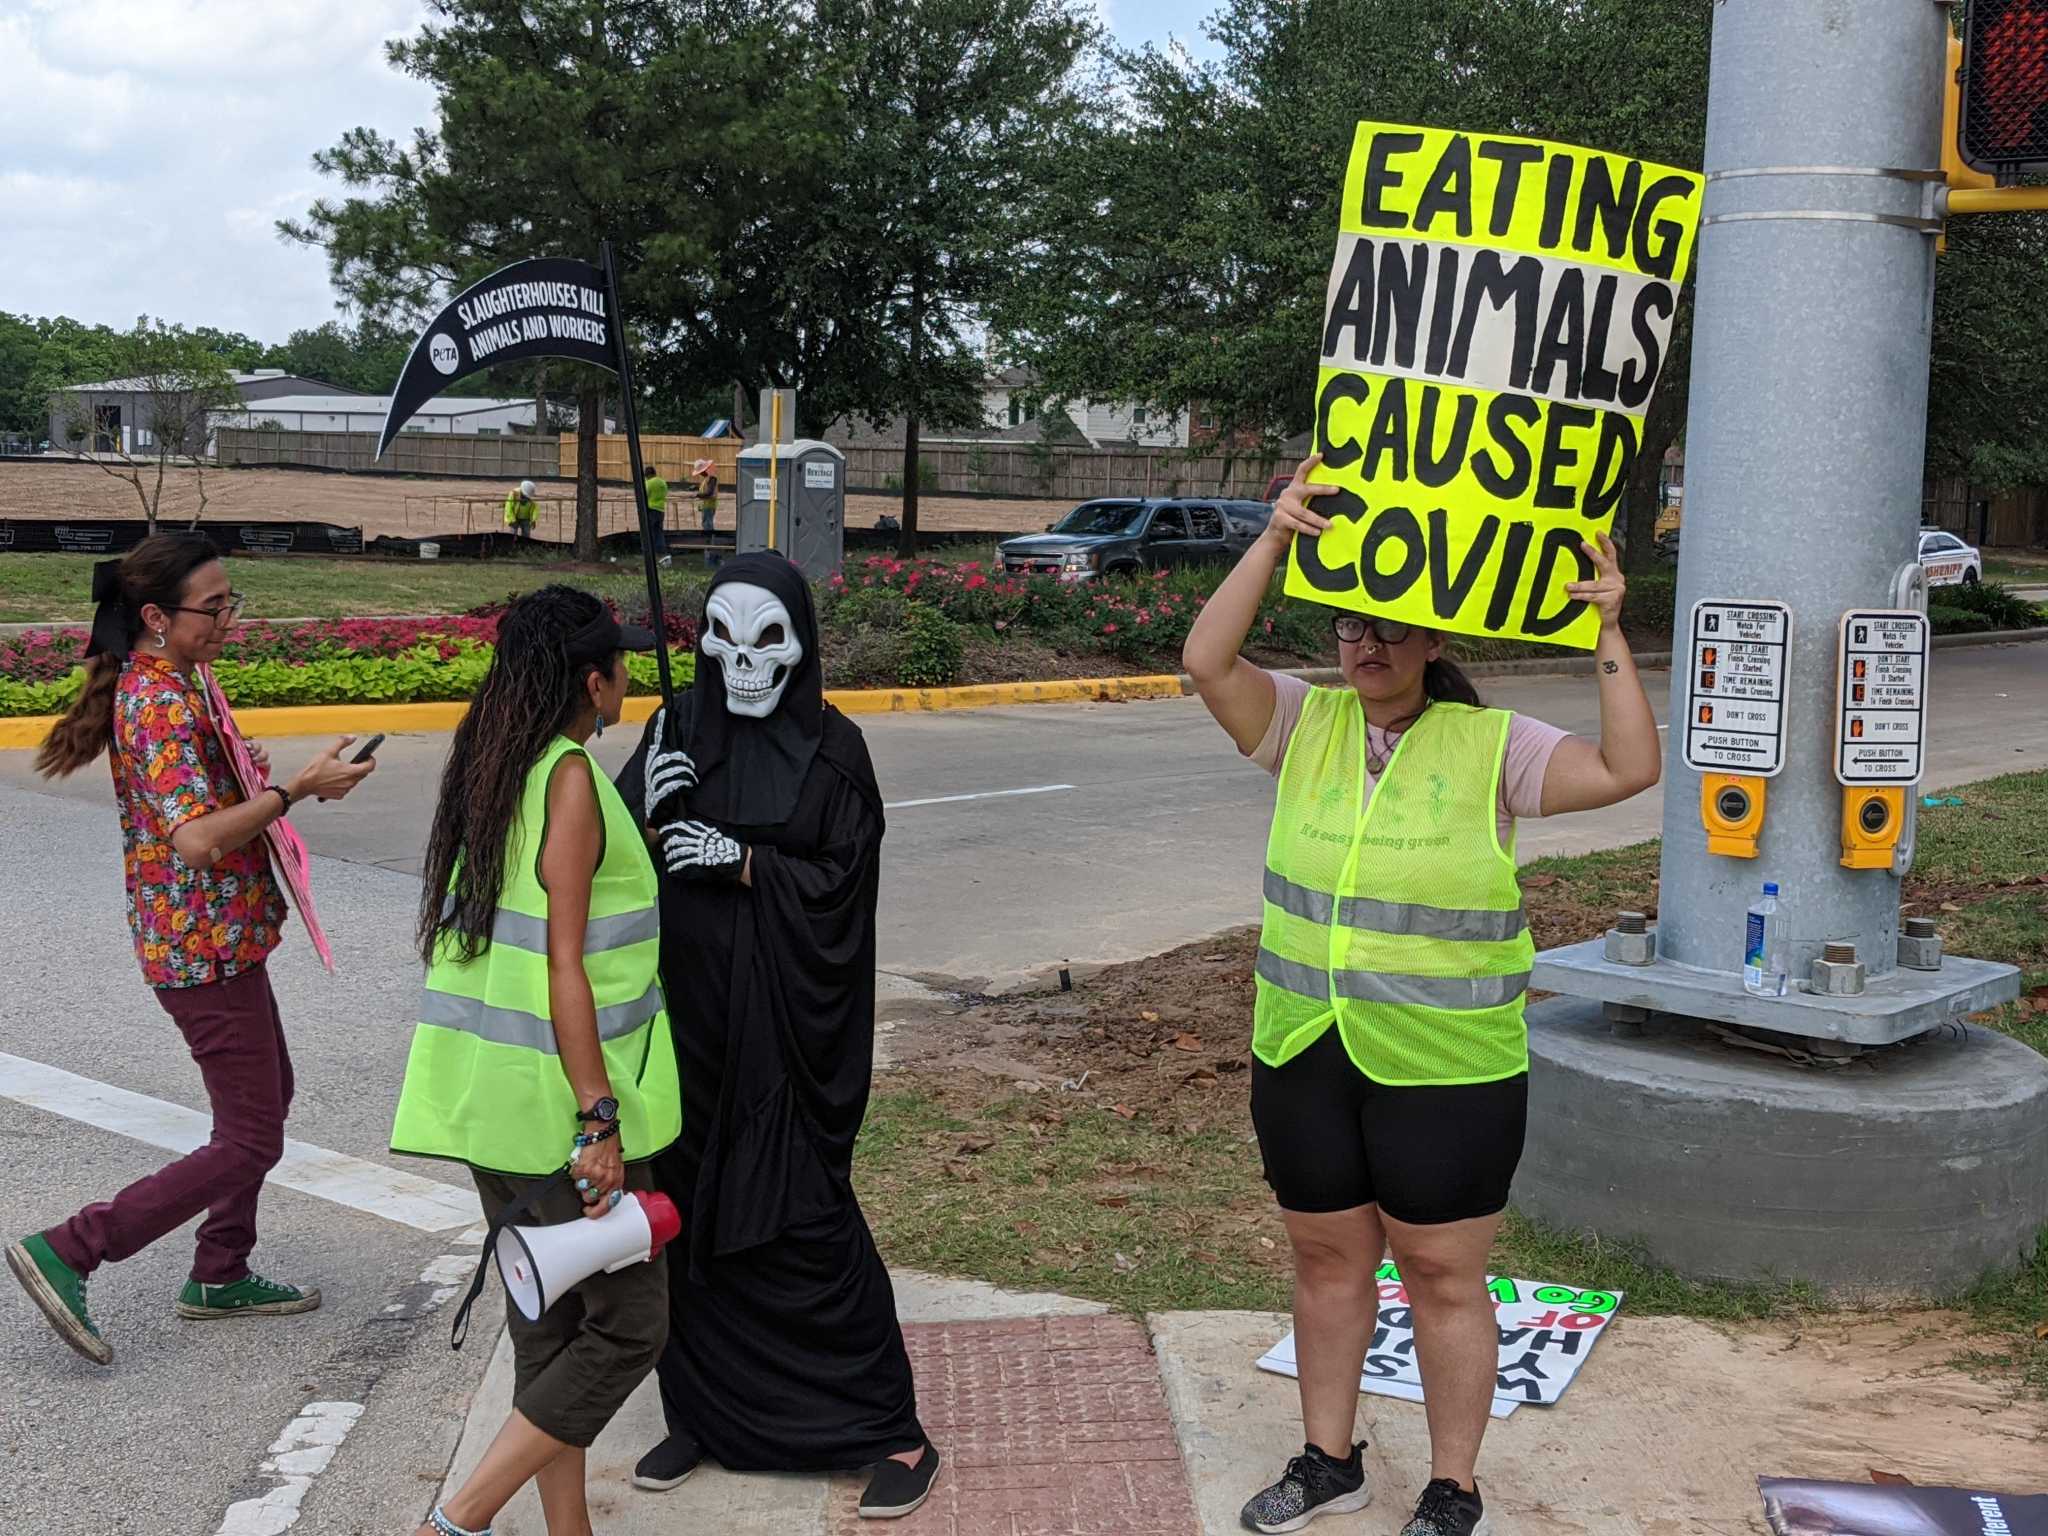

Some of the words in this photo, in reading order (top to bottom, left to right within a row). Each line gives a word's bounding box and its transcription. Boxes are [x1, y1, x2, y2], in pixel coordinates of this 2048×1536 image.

[1360, 133, 1695, 280] EATING
[457, 281, 578, 331] SLAUGHTERHOUSES
[579, 286, 606, 318] KILL
[1322, 238, 1673, 408] ANIMALS
[468, 320, 521, 362] ANIMALS
[522, 315, 548, 341] AND
[549, 314, 606, 347] WORKERS
[1316, 373, 1638, 520] CAUSED
[1296, 487, 1596, 637] COVID
[1926, 563, 1963, 578] SHERIFF
[1726, 610, 1744, 619] START
[1747, 611, 1777, 620] CROSSING
[1874, 622, 1889, 630] START
[1892, 622, 1917, 630] CROSSING
[1730, 644, 1748, 652] DON'T
[1752, 645, 1768, 653] START
[1723, 676, 1736, 684] TIME
[1740, 677, 1773, 687] REMAINING
[1886, 688, 1914, 696] REMAINING
[1726, 710, 1744, 719] DON'T
[1747, 712, 1766, 721] CROSS
[1708, 736, 1728, 744] PUSH
[1731, 737, 1760, 747] BUTTON
[1714, 752, 1723, 760] TO
[1727, 752, 1751, 762] CROSS
[1858, 749, 1876, 757] PUSH
[1879, 749, 1903, 757] BUTTON
[1864, 764, 1872, 772] TO
[1875, 764, 1896, 772] CROSS
[1361, 834, 1405, 850] being
[1408, 834, 1450, 850] green
[1517, 1310, 1605, 1330] OF
